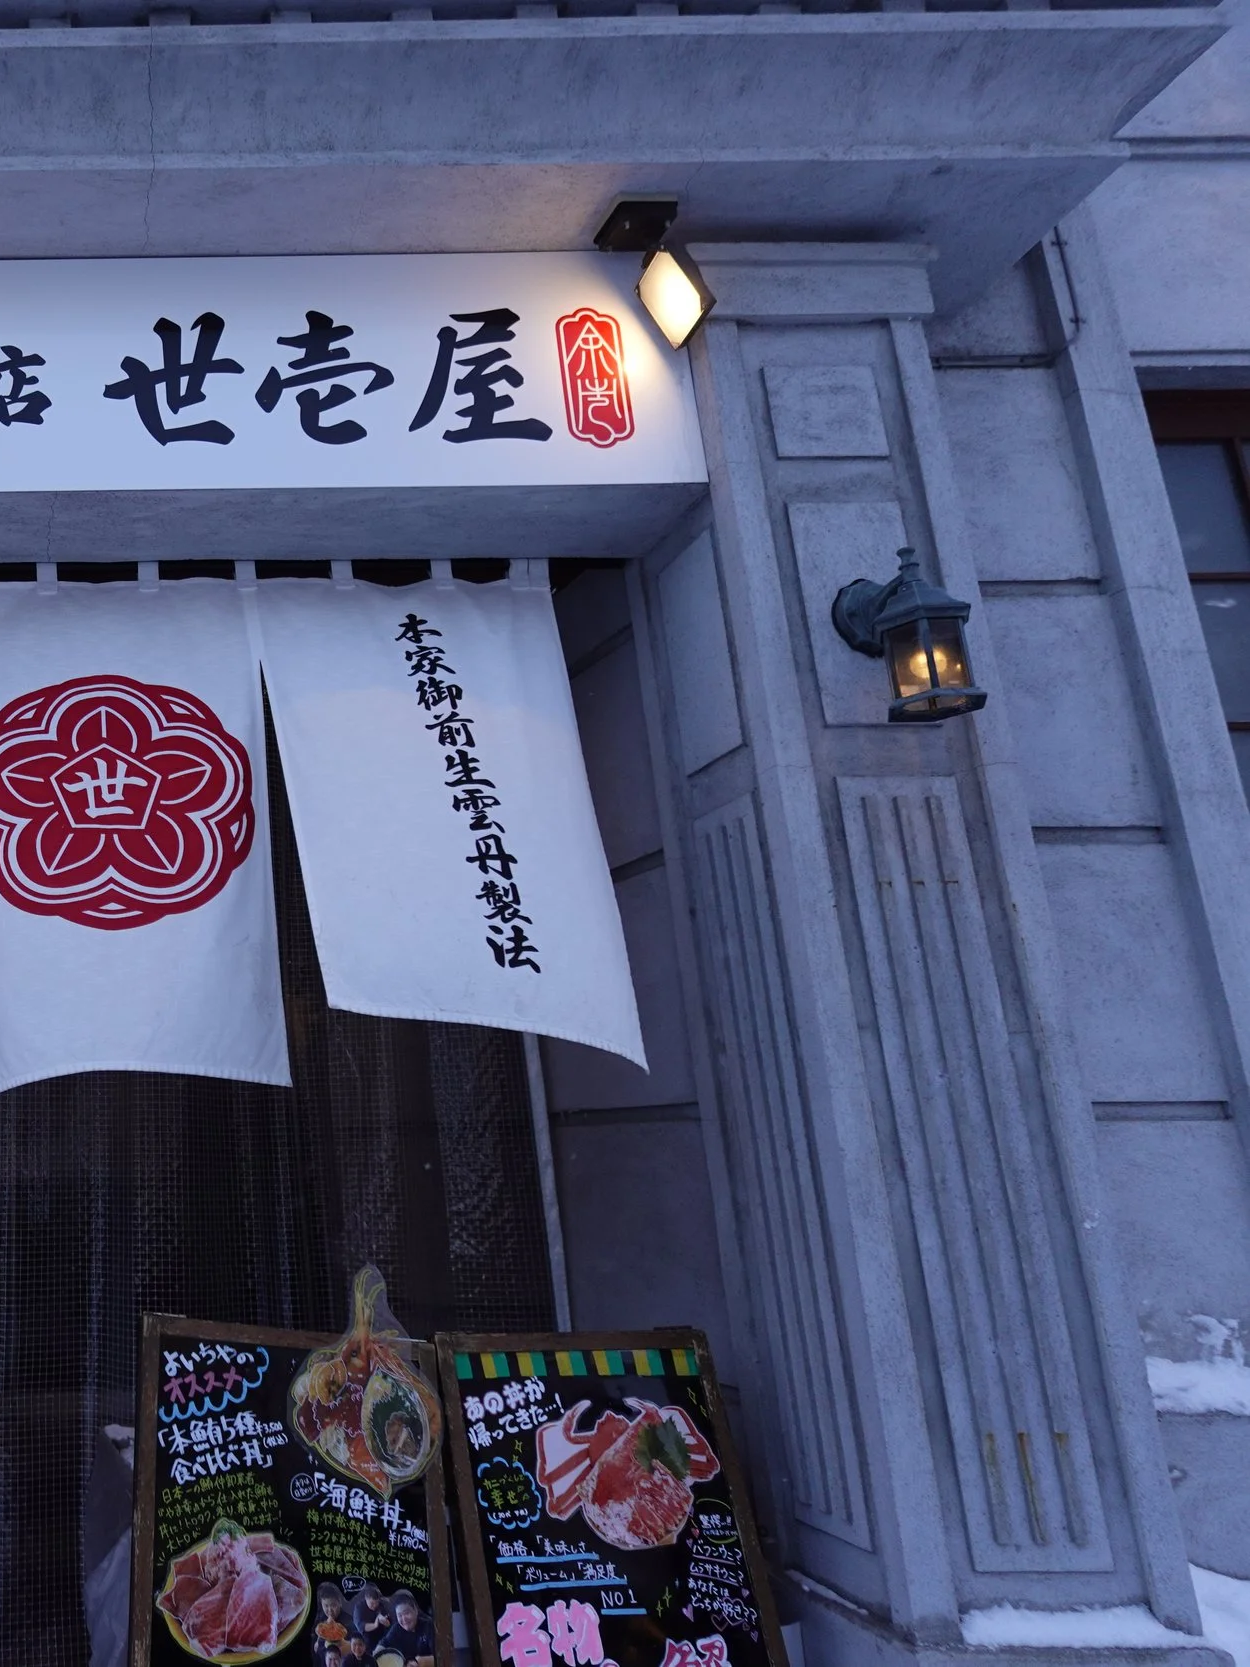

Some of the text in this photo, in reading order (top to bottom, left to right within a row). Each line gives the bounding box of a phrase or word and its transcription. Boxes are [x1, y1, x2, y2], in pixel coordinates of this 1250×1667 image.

[103, 308, 553, 446] 世壱屋
[62, 757, 148, 819] 世
[394, 613, 541, 974] 本家御前生雲丹製法
[163, 1342, 255, 1376] よいちやの
[163, 1366, 243, 1404] オススメ
[464, 1376, 545, 1422] あの丼が
[170, 1439, 273, 1485] 食べ比べ丼」
[314, 1472, 412, 1533] 「海鮮丼」
[689, 1562, 744, 1586] ムラサキウニ?
[692, 1540, 743, 1565] バフンウニ?
[688, 1577, 730, 1597] あなたは
[497, 1598, 605, 1667] 名物
